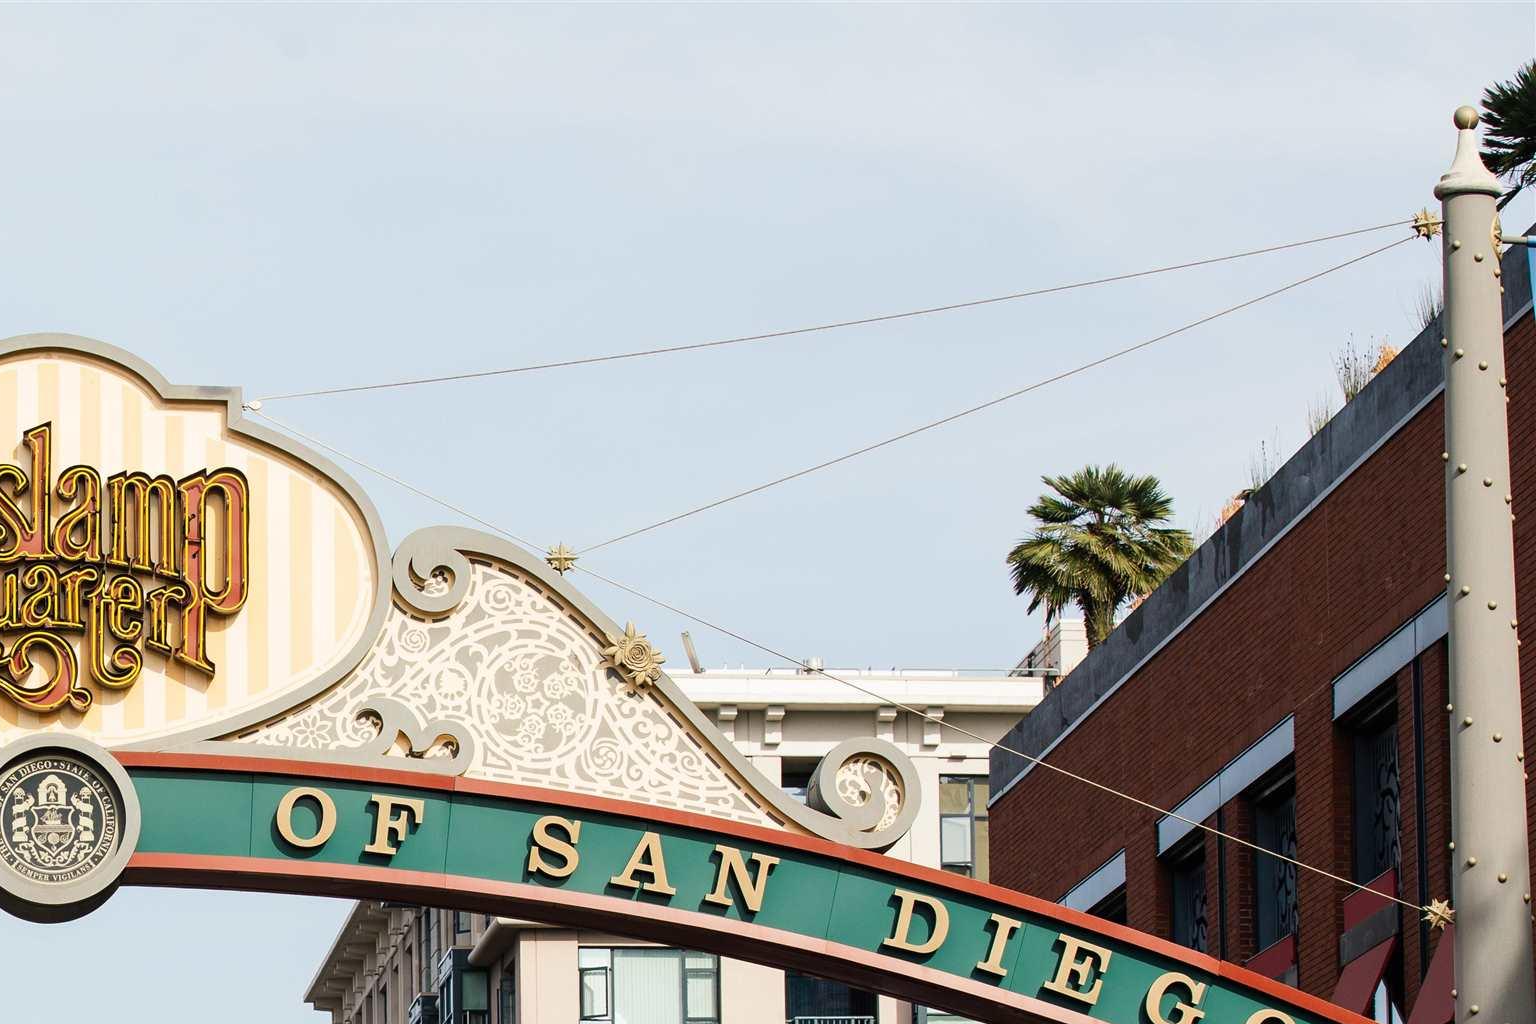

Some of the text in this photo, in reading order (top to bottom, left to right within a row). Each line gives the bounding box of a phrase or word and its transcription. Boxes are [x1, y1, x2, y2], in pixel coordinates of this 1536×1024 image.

[19, 760, 52, 777] DIEGO
[59, 761, 90, 781] STATE
[1, 773, 20, 794] SAN
[92, 780, 105, 795] OF
[96, 793, 115, 862] CALIFORNIA
[275, 787, 425, 856] OF
[527, 815, 780, 913] SAN
[16, 863, 94, 882] SEMPER VIGILANS
